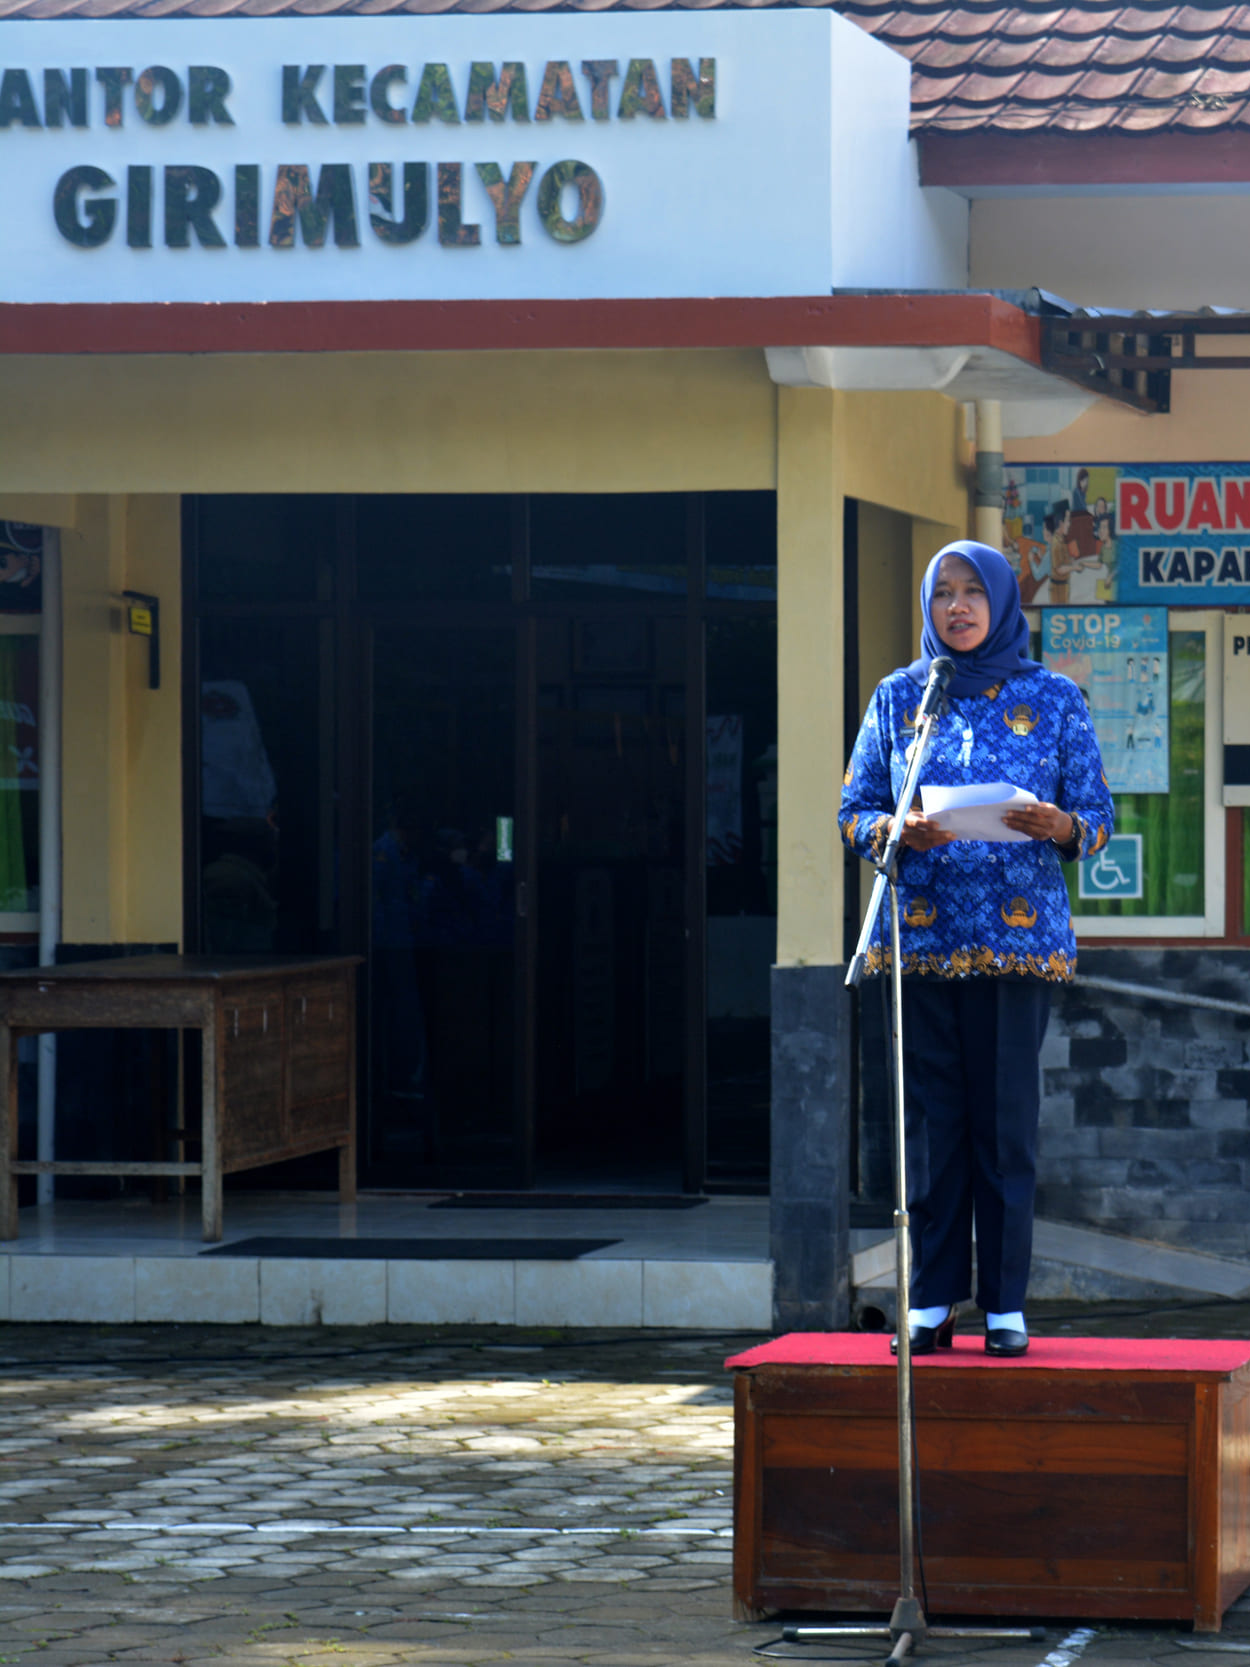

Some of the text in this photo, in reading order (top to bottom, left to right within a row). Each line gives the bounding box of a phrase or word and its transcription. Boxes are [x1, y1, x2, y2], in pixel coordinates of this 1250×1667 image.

[0, 57, 716, 128] ANTOR KECAMATAN
[53, 159, 605, 248] GIRIMULYO
[1049, 613, 1121, 635] STOP
[1050, 635, 1121, 649] Covid-19
